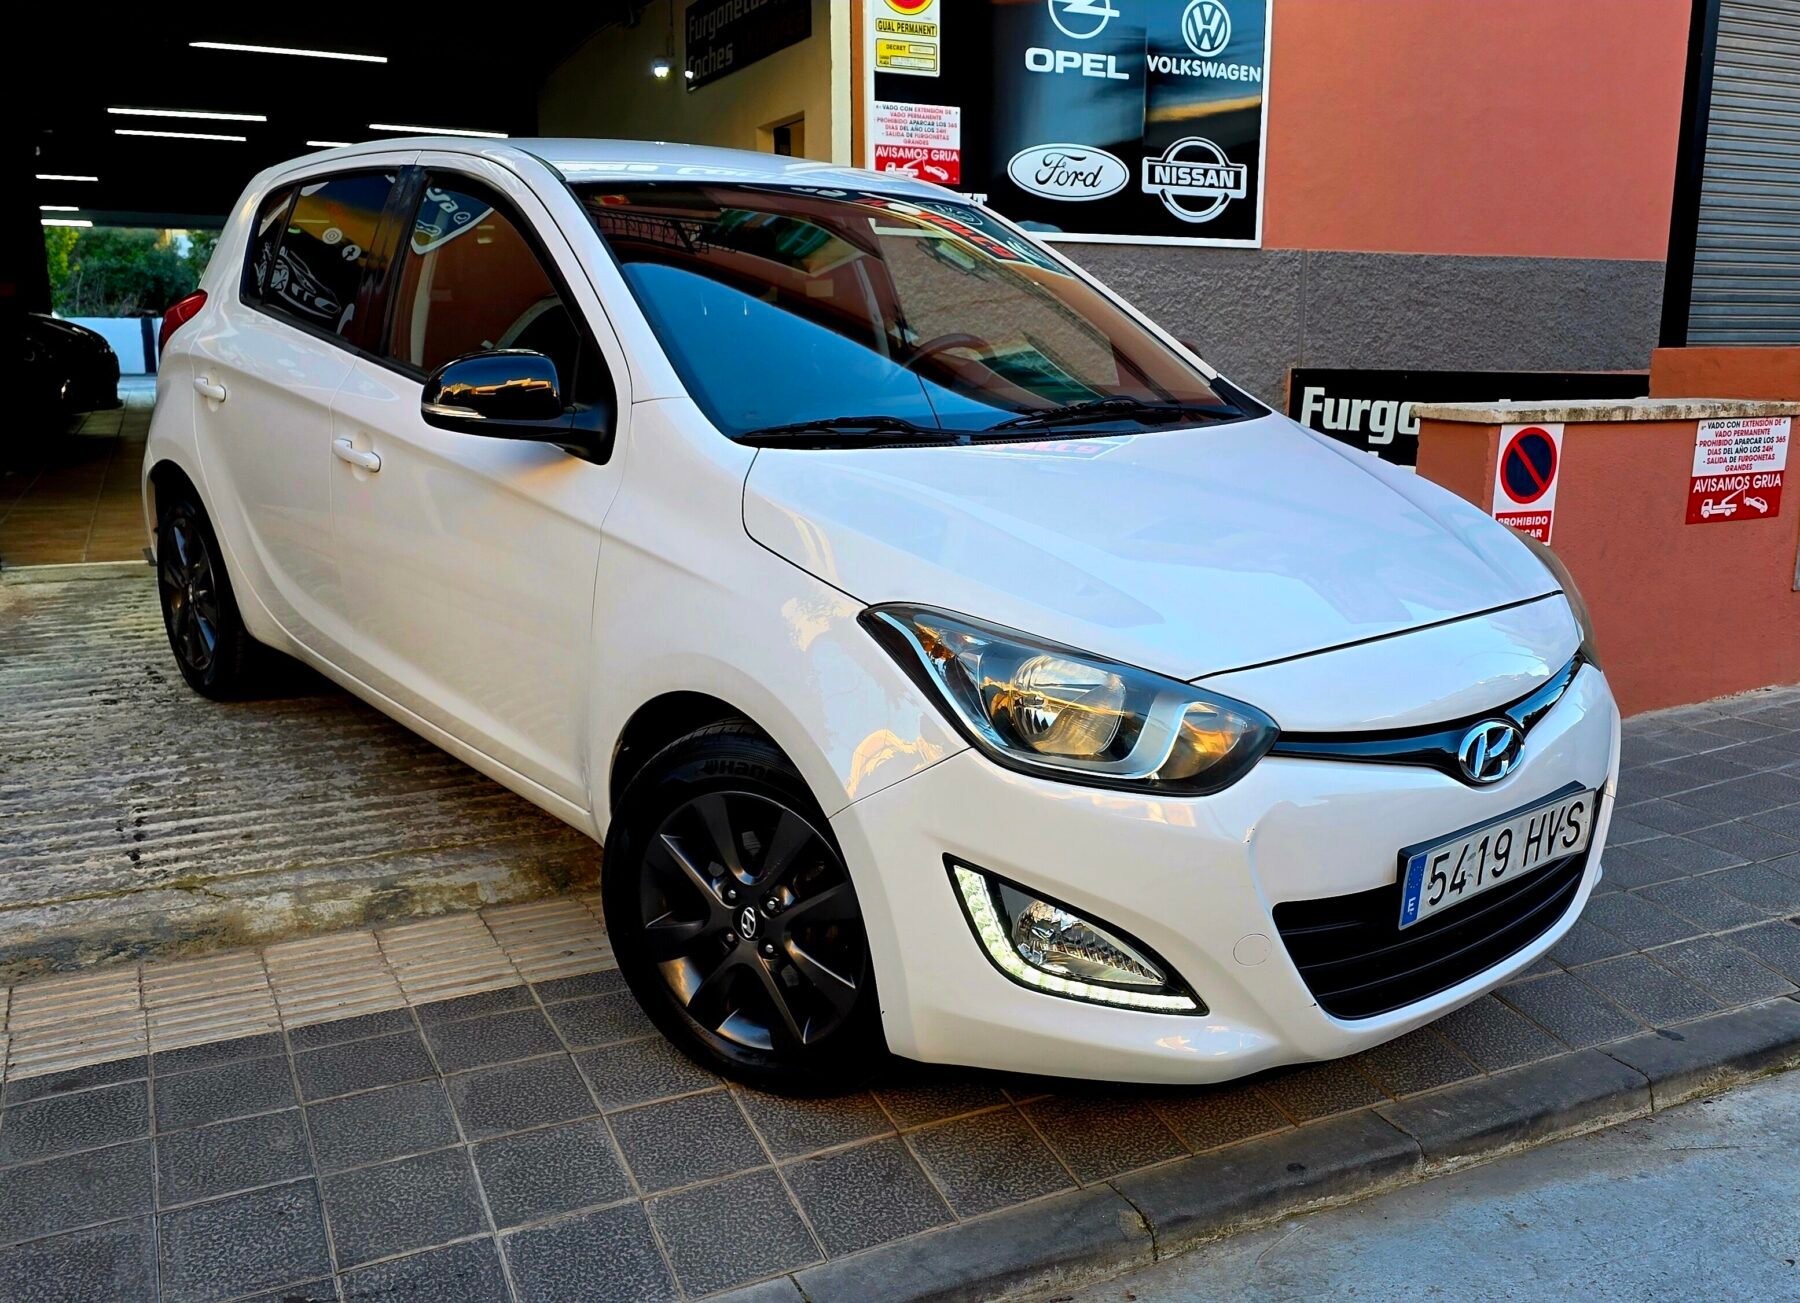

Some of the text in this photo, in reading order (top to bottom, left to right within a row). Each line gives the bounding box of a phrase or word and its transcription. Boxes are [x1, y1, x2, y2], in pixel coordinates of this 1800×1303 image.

[878, 20, 935, 35] GUAL PERMANENT
[1025, 47, 1130, 80] OPEL
[1147, 54, 1262, 83] VOLKSWAGEN
[876, 145, 959, 162] AVISAMOS GRUA
[1035, 152, 1104, 188] Ford
[1154, 165, 1235, 188] NISSAN
[1708, 421, 1725, 429] VADO
[1742, 418, 1774, 427] EXTENSIÓN
[1699, 439, 1733, 447] PROHIBIDO
[1734, 437, 1762, 445] APARCAR
[1763, 436, 1774, 444] LOS
[1715, 428, 1770, 438] VADO PERMANENTE
[1723, 447, 1734, 455] DEL
[1735, 445, 1748, 454] AÑO
[1738, 454, 1775, 462] FURGONETAS
[1725, 463, 1752, 472] GRANDES
[1693, 474, 1782, 493] AVISAMOS GRUA
[1427, 801, 1585, 907] 5419 HVS
[1408, 896, 1416, 915] E
